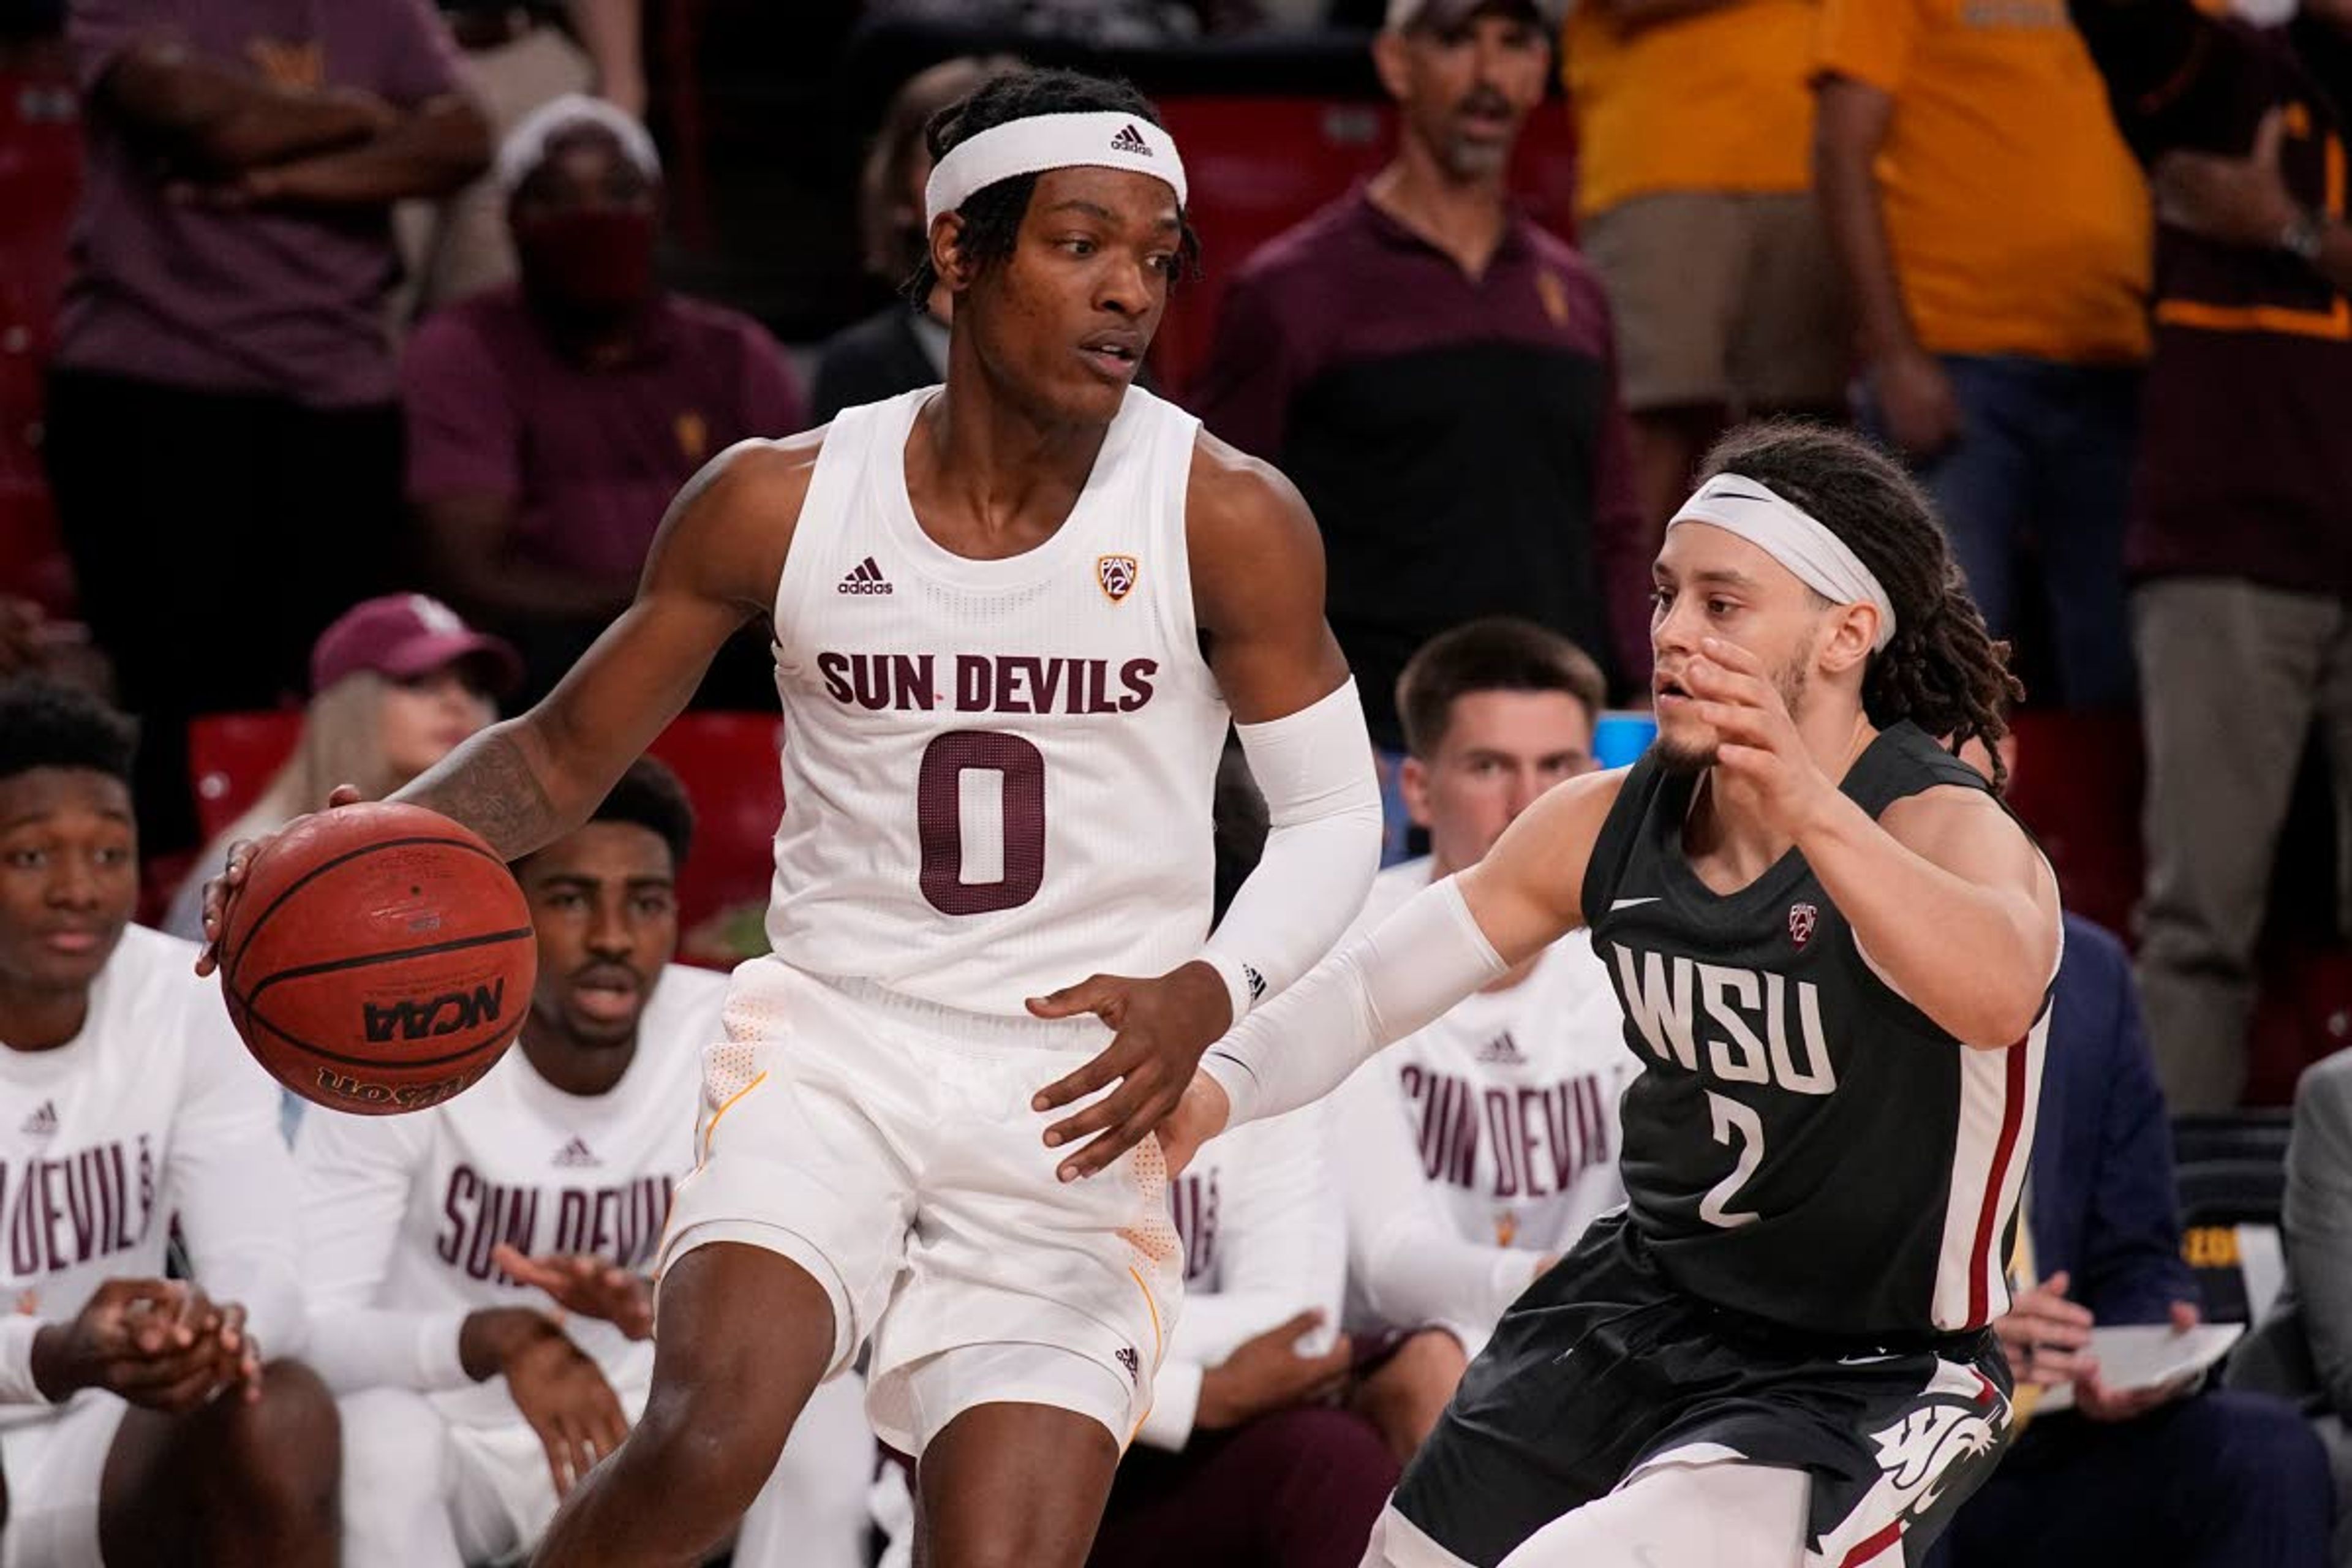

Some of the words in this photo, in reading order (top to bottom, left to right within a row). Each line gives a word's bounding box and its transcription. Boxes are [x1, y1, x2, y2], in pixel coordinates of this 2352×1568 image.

[1110, 141, 1153, 157] adidas
[837, 580, 892, 594] adidas
[818, 652, 935, 710] SUN
[956, 655, 1158, 714] DEVILS
[918, 730, 1045, 916] 0
[363, 976, 503, 1042] NCAA
[1610, 940, 1838, 1095] WSU
[1699, 1088, 1765, 1229] 2
[438, 1165, 538, 1287] SUN
